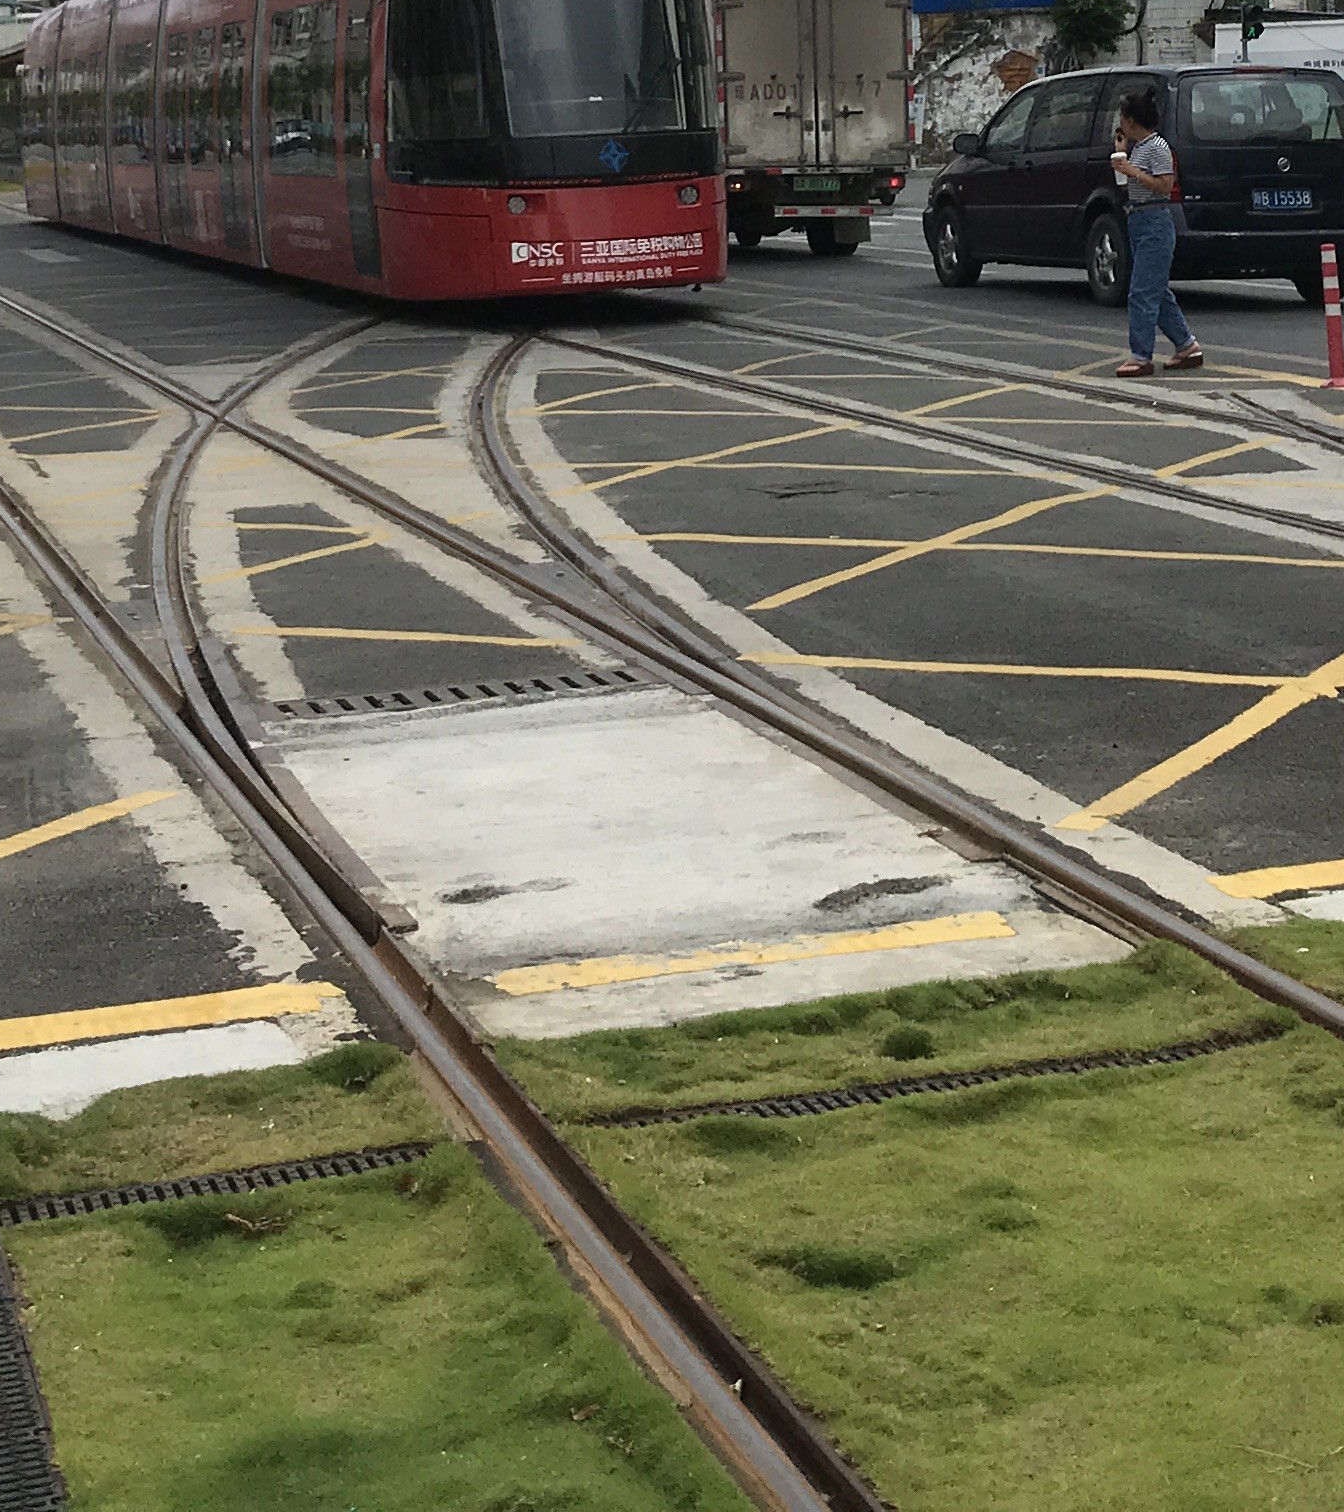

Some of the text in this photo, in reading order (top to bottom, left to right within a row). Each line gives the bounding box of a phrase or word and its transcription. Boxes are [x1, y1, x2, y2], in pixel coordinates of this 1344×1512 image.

[515, 242, 564, 259] CNSC
[580, 232, 703, 257] 三亚国际免税购物公园
